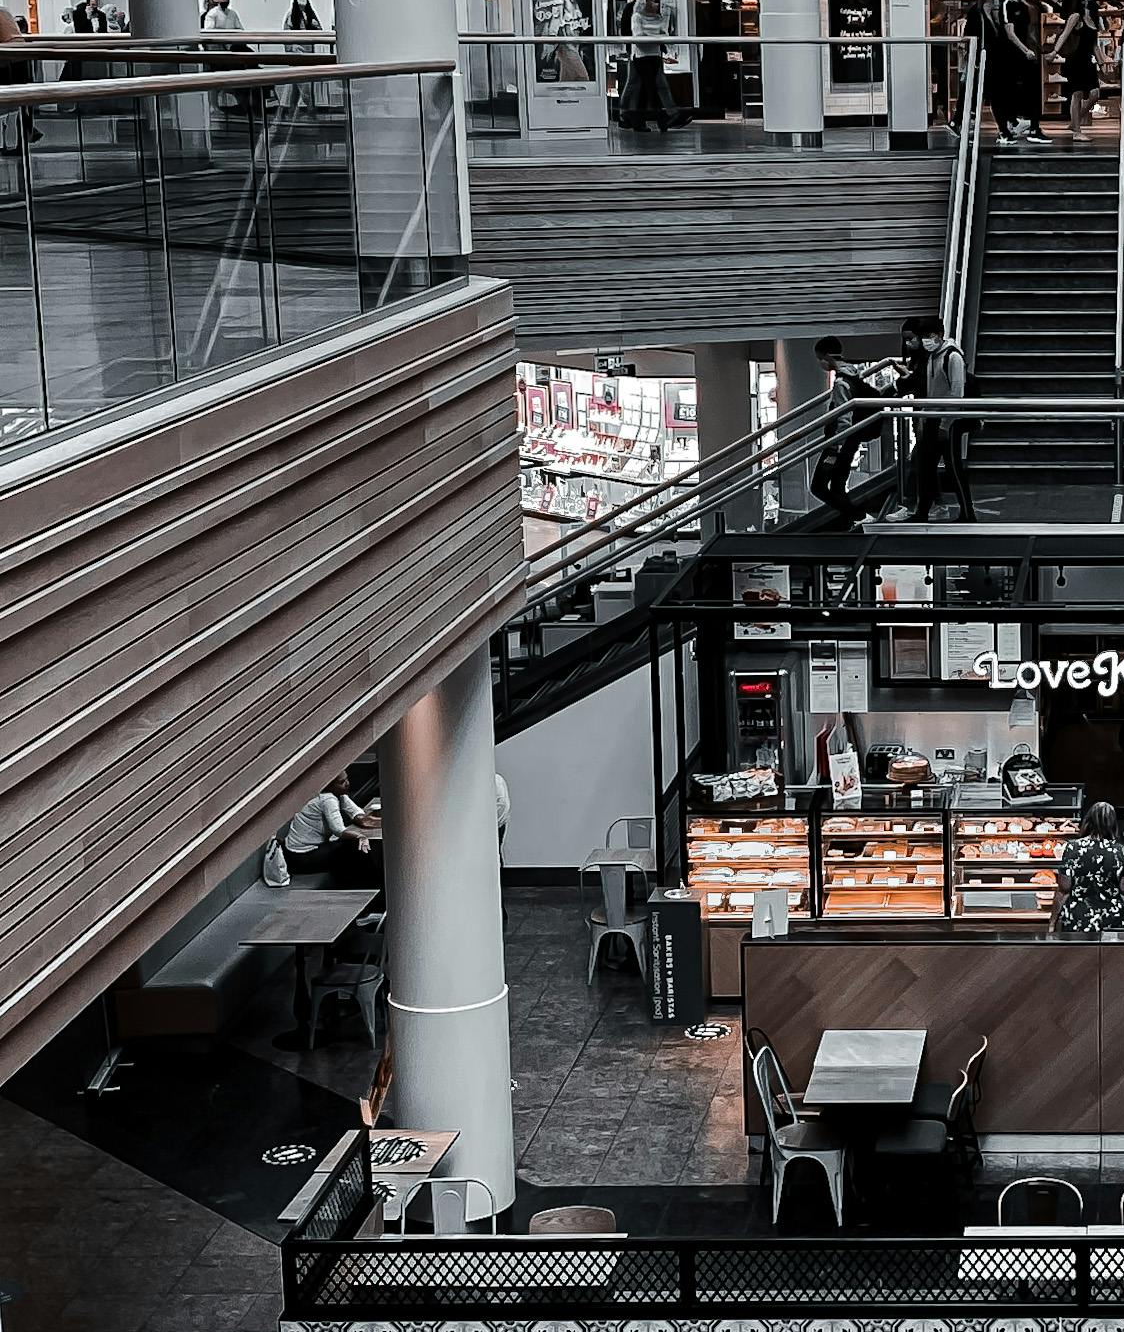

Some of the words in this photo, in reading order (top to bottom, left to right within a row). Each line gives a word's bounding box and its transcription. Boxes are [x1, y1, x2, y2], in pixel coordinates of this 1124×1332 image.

[651, 911, 661, 942] Instant
[652, 943, 662, 995] Sanitisation
[664, 934, 674, 969] BAKERS
[666, 976, 676, 1019] BARISTAS
